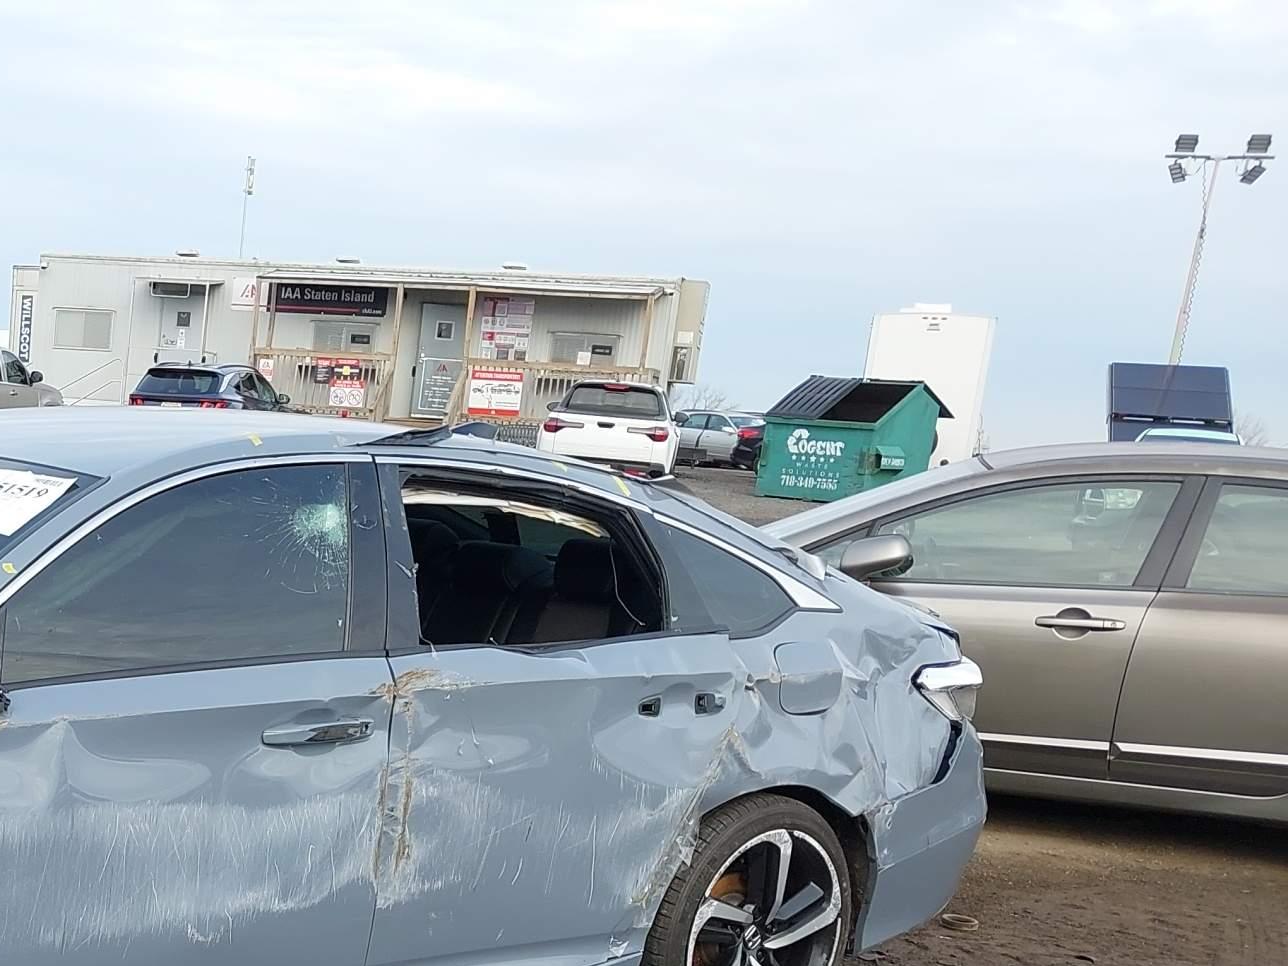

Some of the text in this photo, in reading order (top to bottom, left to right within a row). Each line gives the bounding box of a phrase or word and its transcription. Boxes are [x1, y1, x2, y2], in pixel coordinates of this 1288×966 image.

[281, 286, 375, 303] IAA Staten Island
[20, 298, 32, 360] WILLSCOT
[782, 467, 840, 478] SOLUTIONS
[796, 462, 828, 470] WASTE
